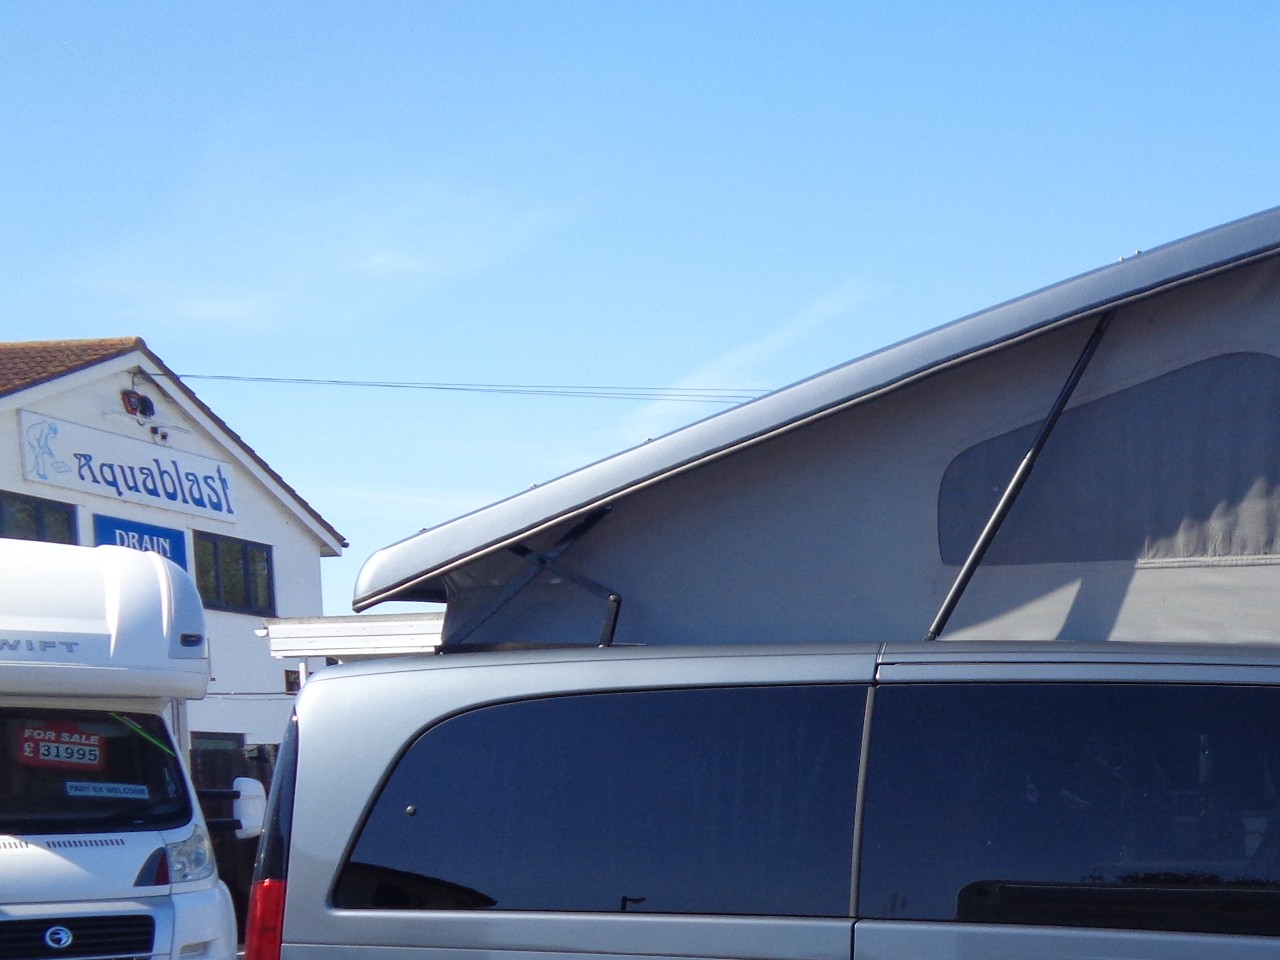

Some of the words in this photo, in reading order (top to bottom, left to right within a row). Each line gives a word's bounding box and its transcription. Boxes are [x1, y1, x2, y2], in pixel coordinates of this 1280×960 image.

[73, 453, 234, 515] Aquablast
[115, 529, 171, 557] DRAIN
[24, 729, 56, 740] FOR
[60, 732, 100, 745] SALE
